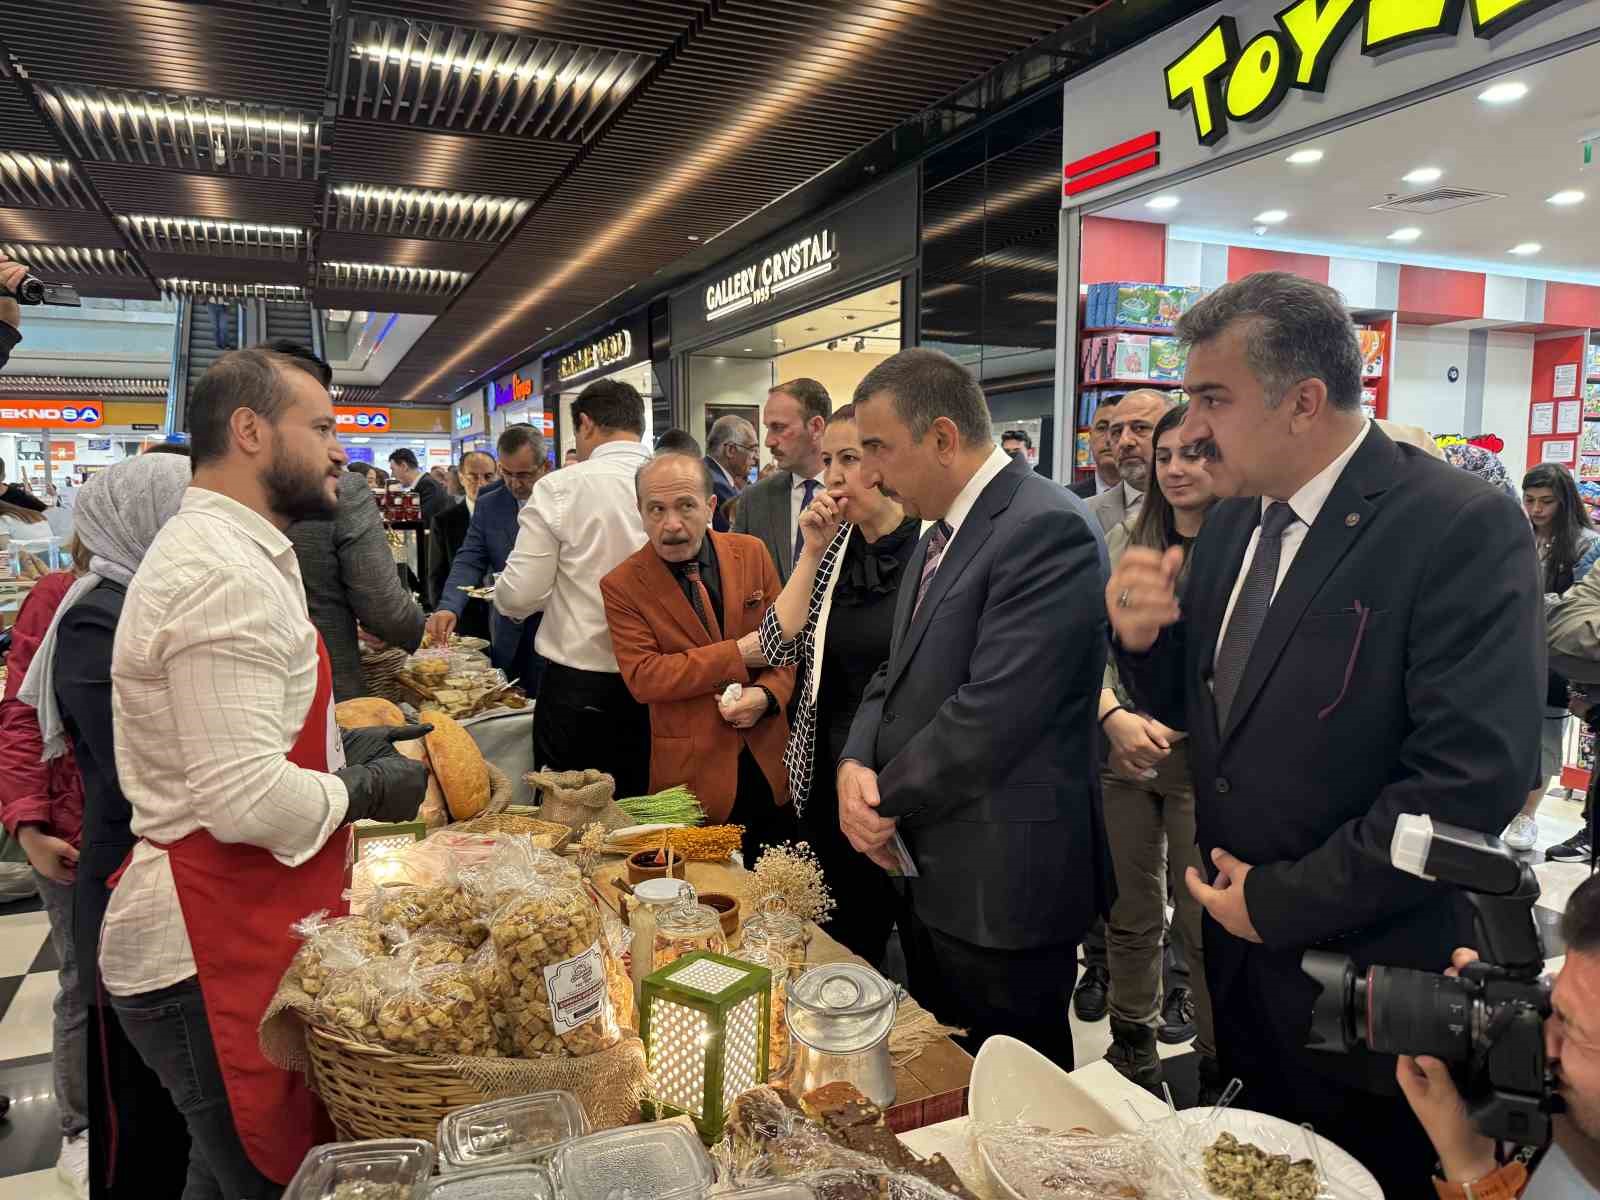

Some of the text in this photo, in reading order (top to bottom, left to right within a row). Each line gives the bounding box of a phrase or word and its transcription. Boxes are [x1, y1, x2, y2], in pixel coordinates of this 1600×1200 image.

[706, 229, 832, 310] GALLERY CRYSTAL
[752, 285, 771, 305] 1955
[0, 407, 99, 421] EKNOSA
